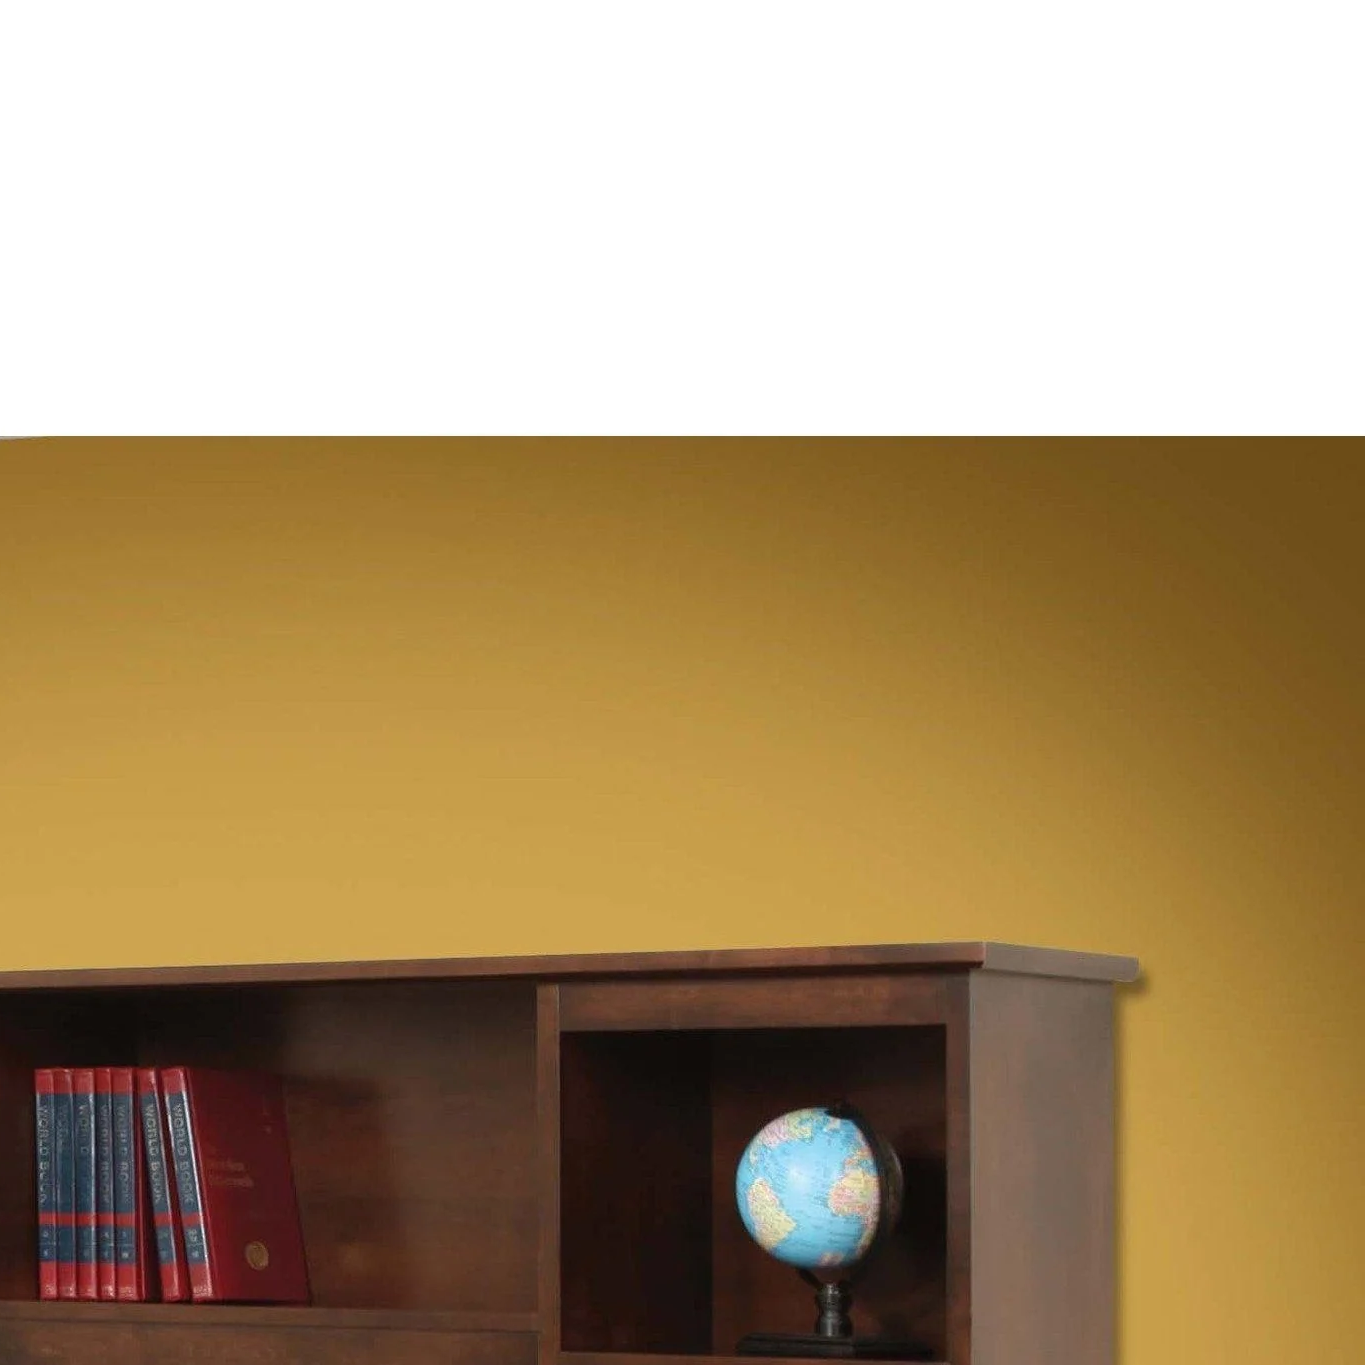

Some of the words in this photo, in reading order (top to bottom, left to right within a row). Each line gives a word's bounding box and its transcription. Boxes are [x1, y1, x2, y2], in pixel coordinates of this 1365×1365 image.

[38, 1104, 50, 1157] WORLD
[144, 1103, 160, 1157] WORLD
[173, 1102, 189, 1158] WORLD
[150, 1161, 164, 1204] BOOK
[179, 1160, 195, 1204] BOOK
